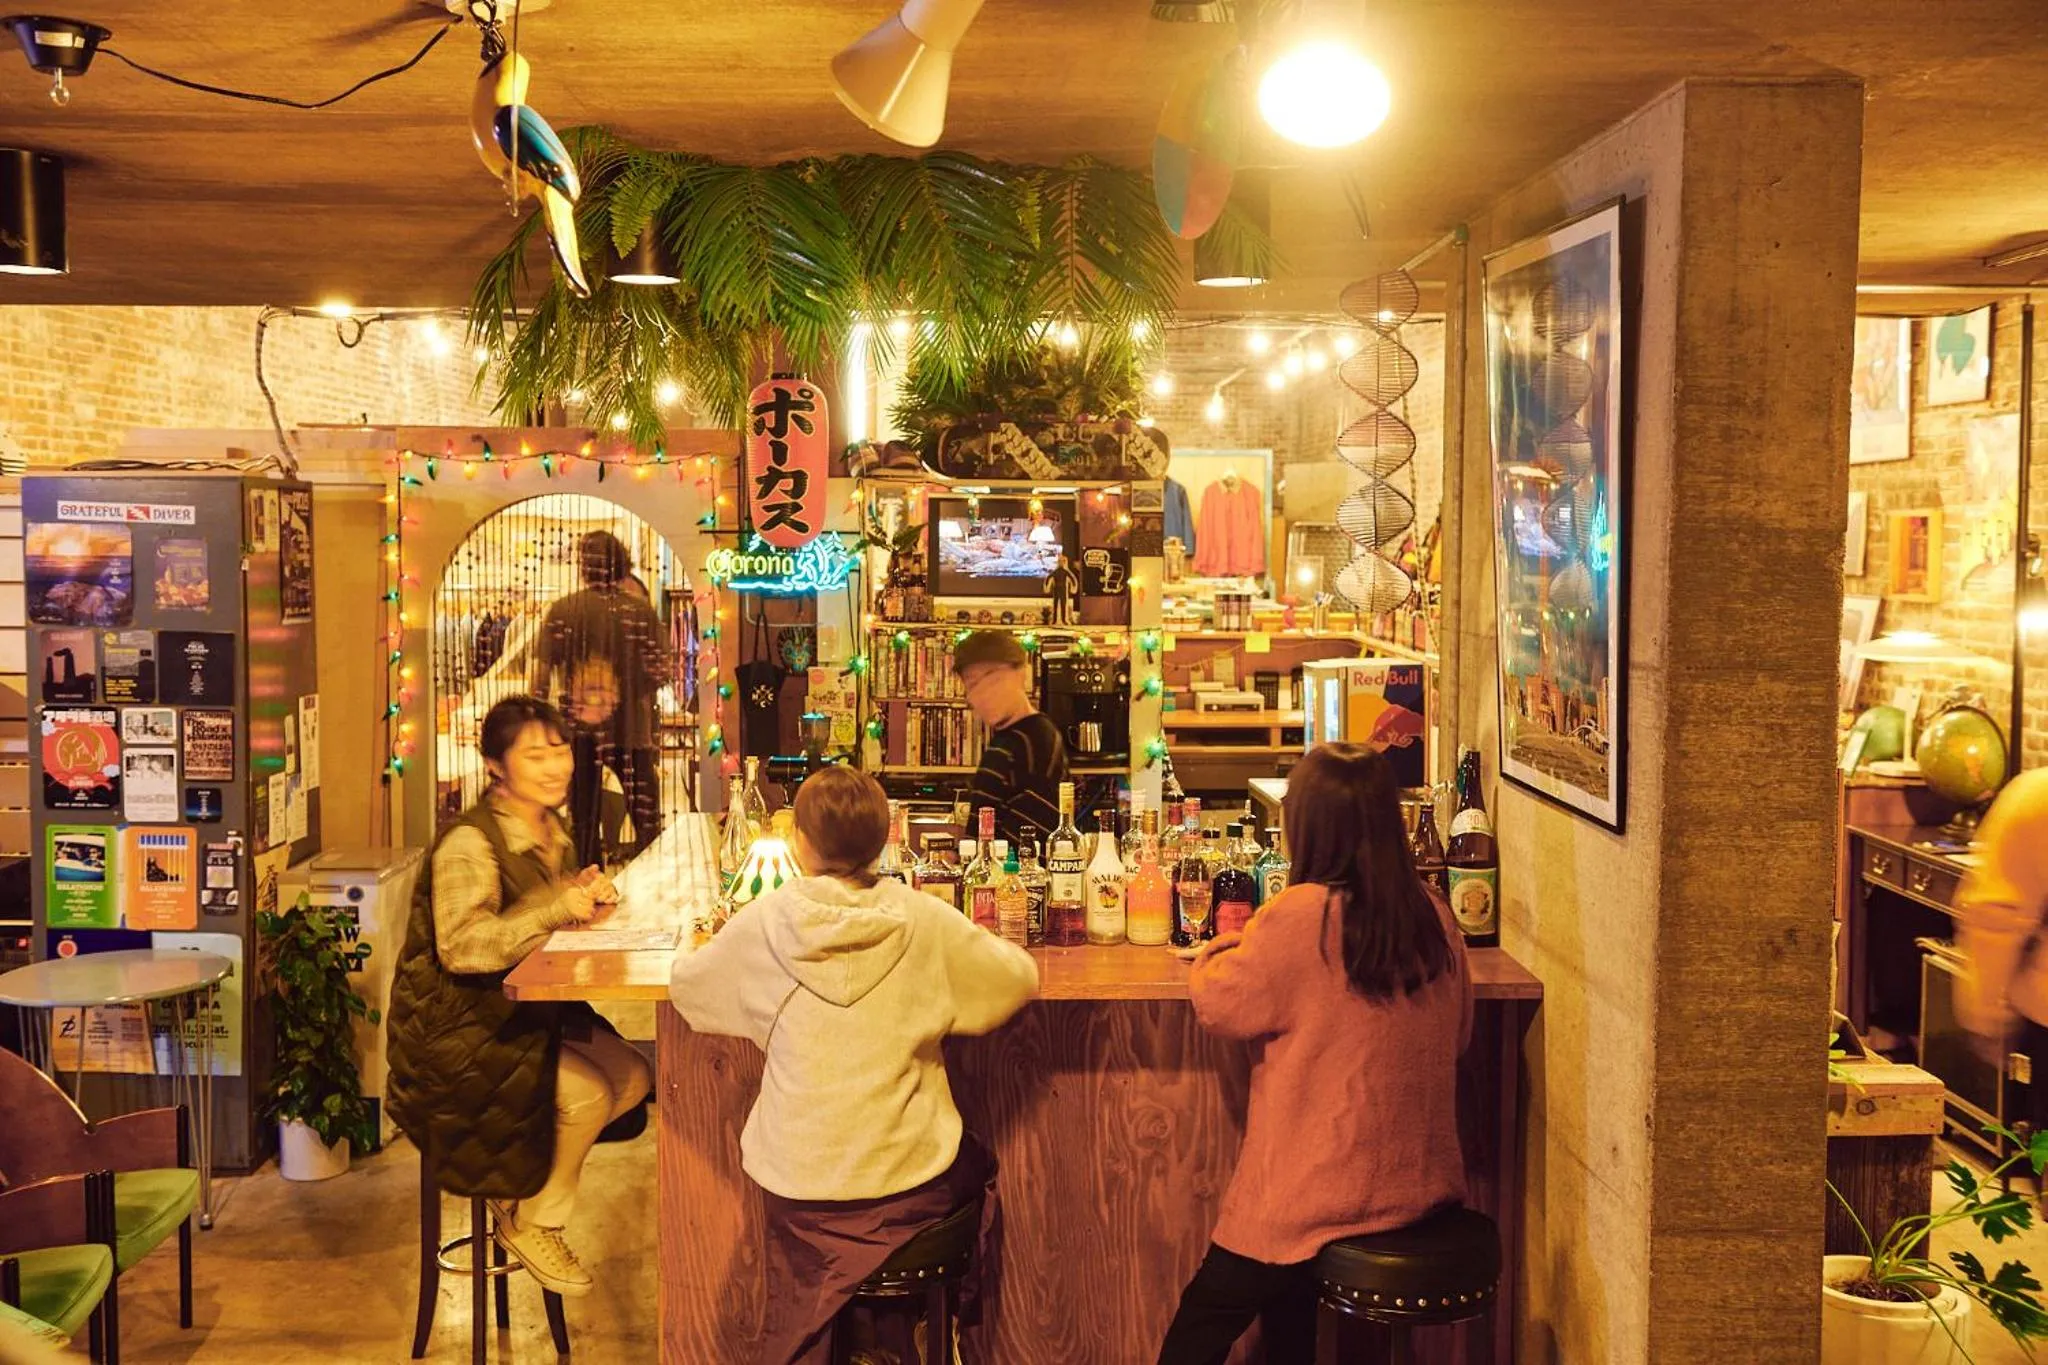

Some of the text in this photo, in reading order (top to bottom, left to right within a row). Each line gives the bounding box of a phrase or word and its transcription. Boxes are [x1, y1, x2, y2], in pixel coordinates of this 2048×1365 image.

[752, 387, 815, 533] ポーカス
[60, 504, 191, 520] GRATEFUL DIVER
[705, 549, 795, 580] Corona
[1353, 670, 1418, 686] Red Bull
